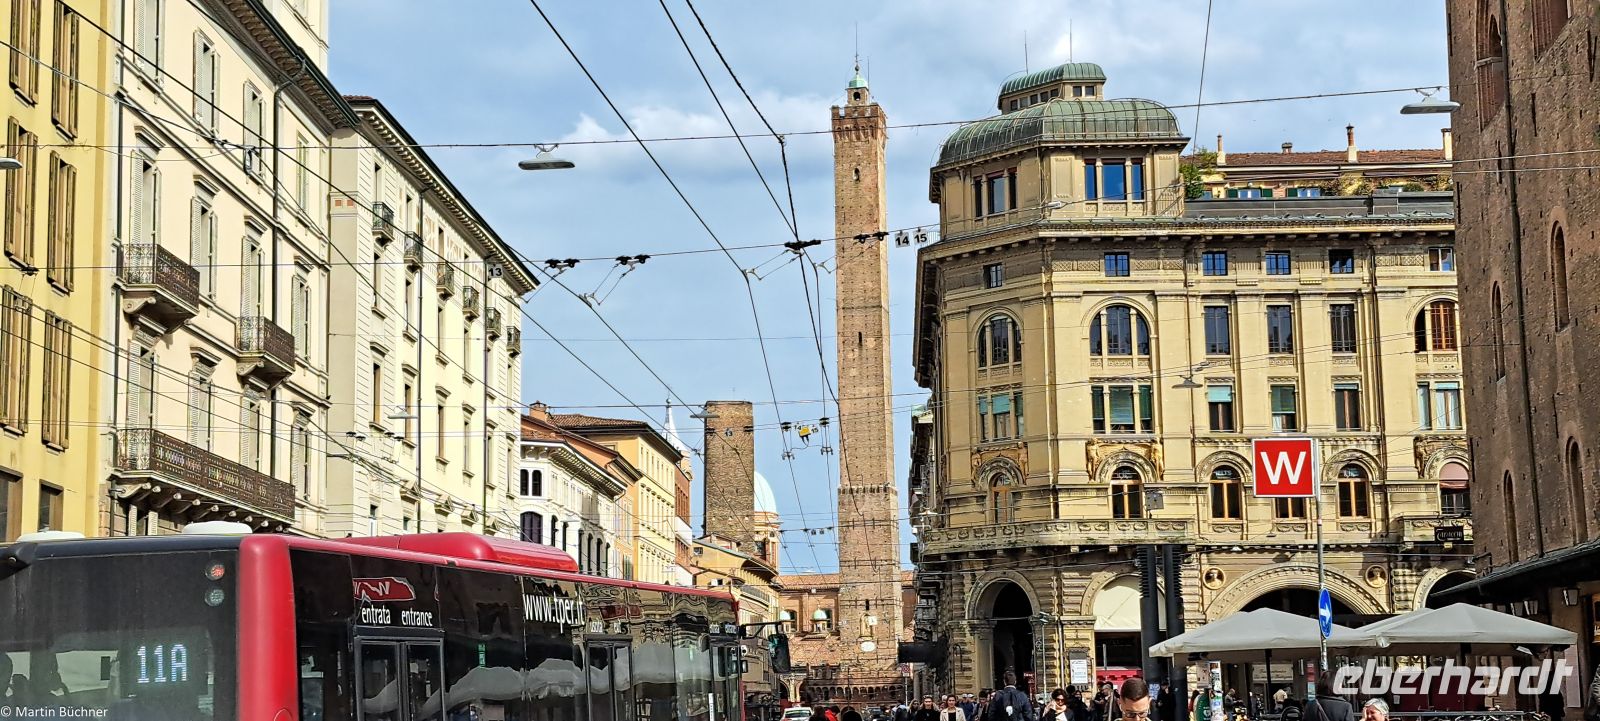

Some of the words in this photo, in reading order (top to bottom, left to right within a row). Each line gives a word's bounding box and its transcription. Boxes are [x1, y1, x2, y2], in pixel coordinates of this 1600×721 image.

[895, 236, 909, 246] 14
[914, 233, 928, 243] 15
[488, 268, 502, 276] 13
[1260, 451, 1307, 485] W
[361, 604, 391, 624] entrata
[401, 607, 433, 627] entrance
[522, 591, 586, 634] www.tper.it
[137, 644, 187, 683] 11A
